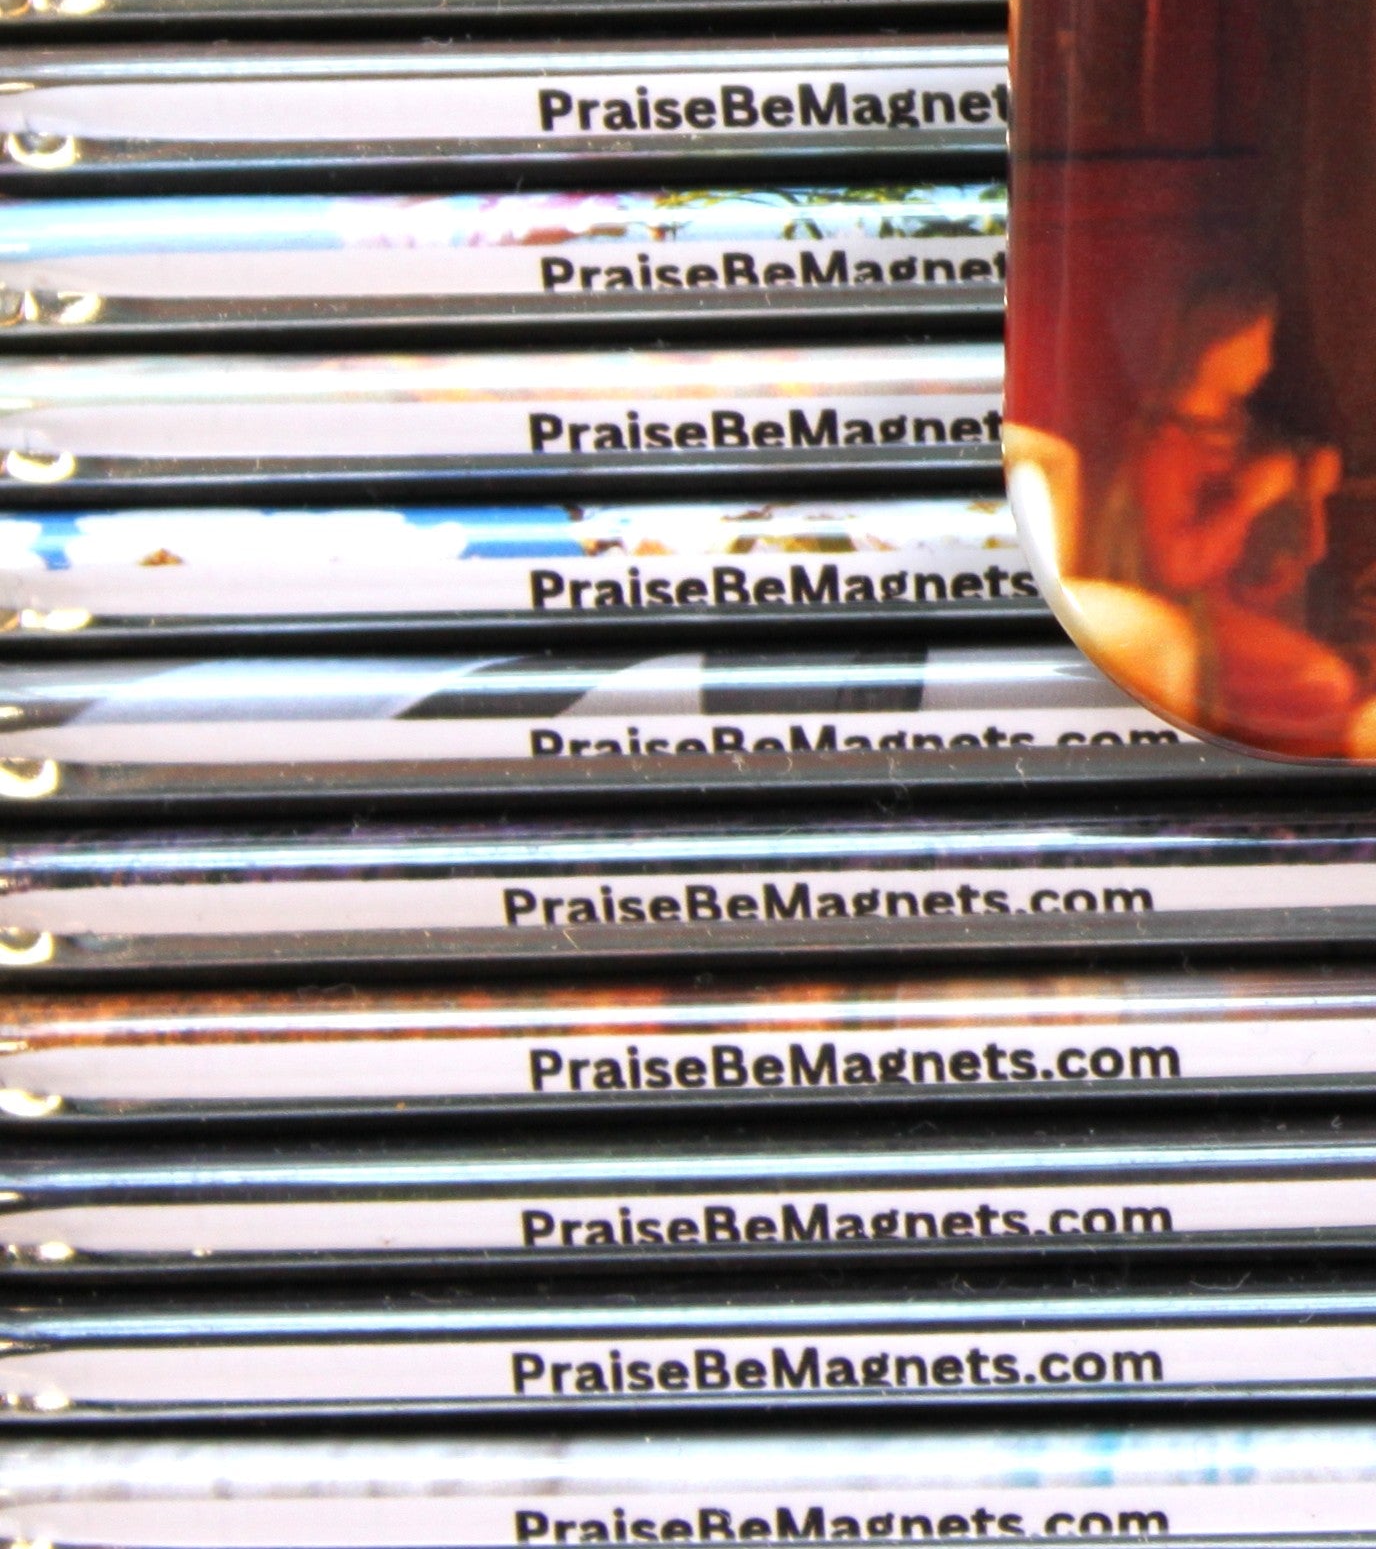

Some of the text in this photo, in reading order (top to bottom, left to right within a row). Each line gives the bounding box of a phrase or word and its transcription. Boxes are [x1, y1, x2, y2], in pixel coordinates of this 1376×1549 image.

[530, 563, 1039, 610] PraiseBeMagnets
[529, 1043, 1182, 1091] PraiseBeMagnets.com
[521, 1203, 1173, 1249] PraiseBeMagnets.com
[511, 1347, 1164, 1394] PraiseBeMagnets.com
